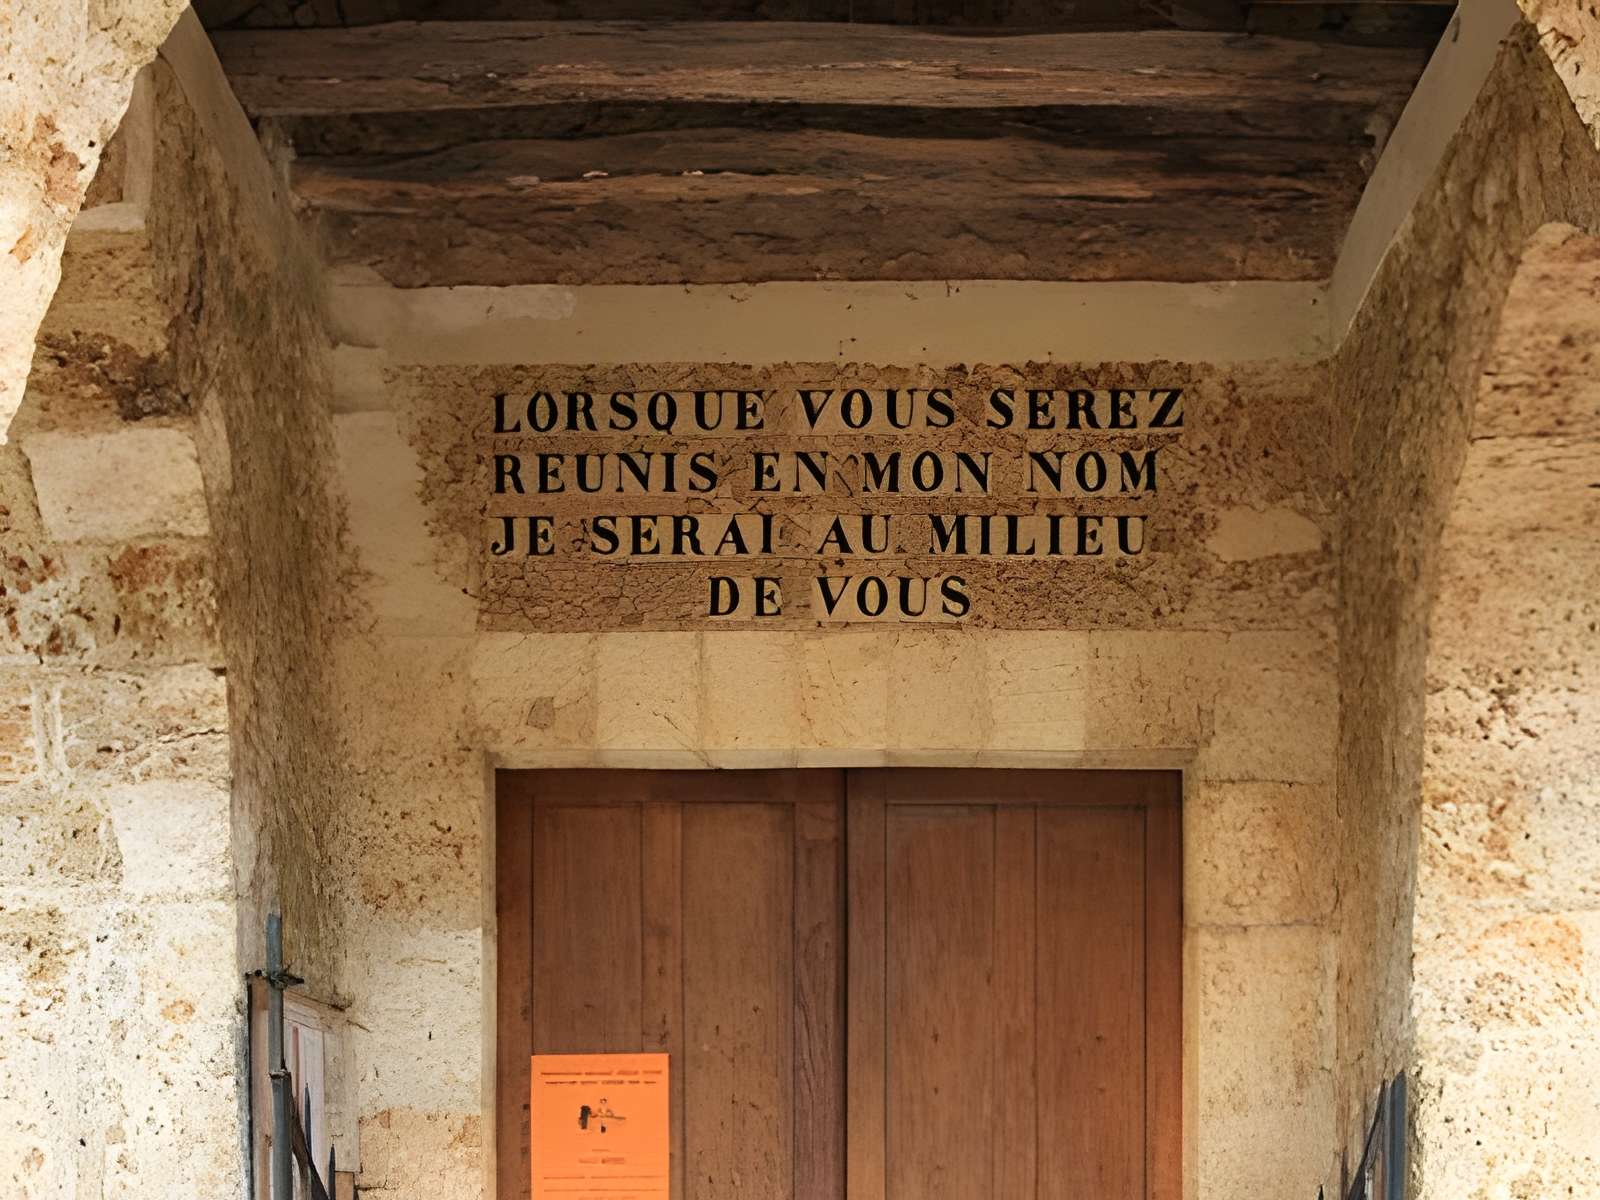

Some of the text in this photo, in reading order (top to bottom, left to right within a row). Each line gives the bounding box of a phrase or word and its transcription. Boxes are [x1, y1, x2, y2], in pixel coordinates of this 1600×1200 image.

[493, 388, 1185, 435] LORSQUE VOUS SEREZ
[493, 450, 1158, 494] REUNIS EN MON NOM
[491, 514, 1147, 556] JE SERAI AU MILIEU
[708, 576, 971, 617] DE VOUS
